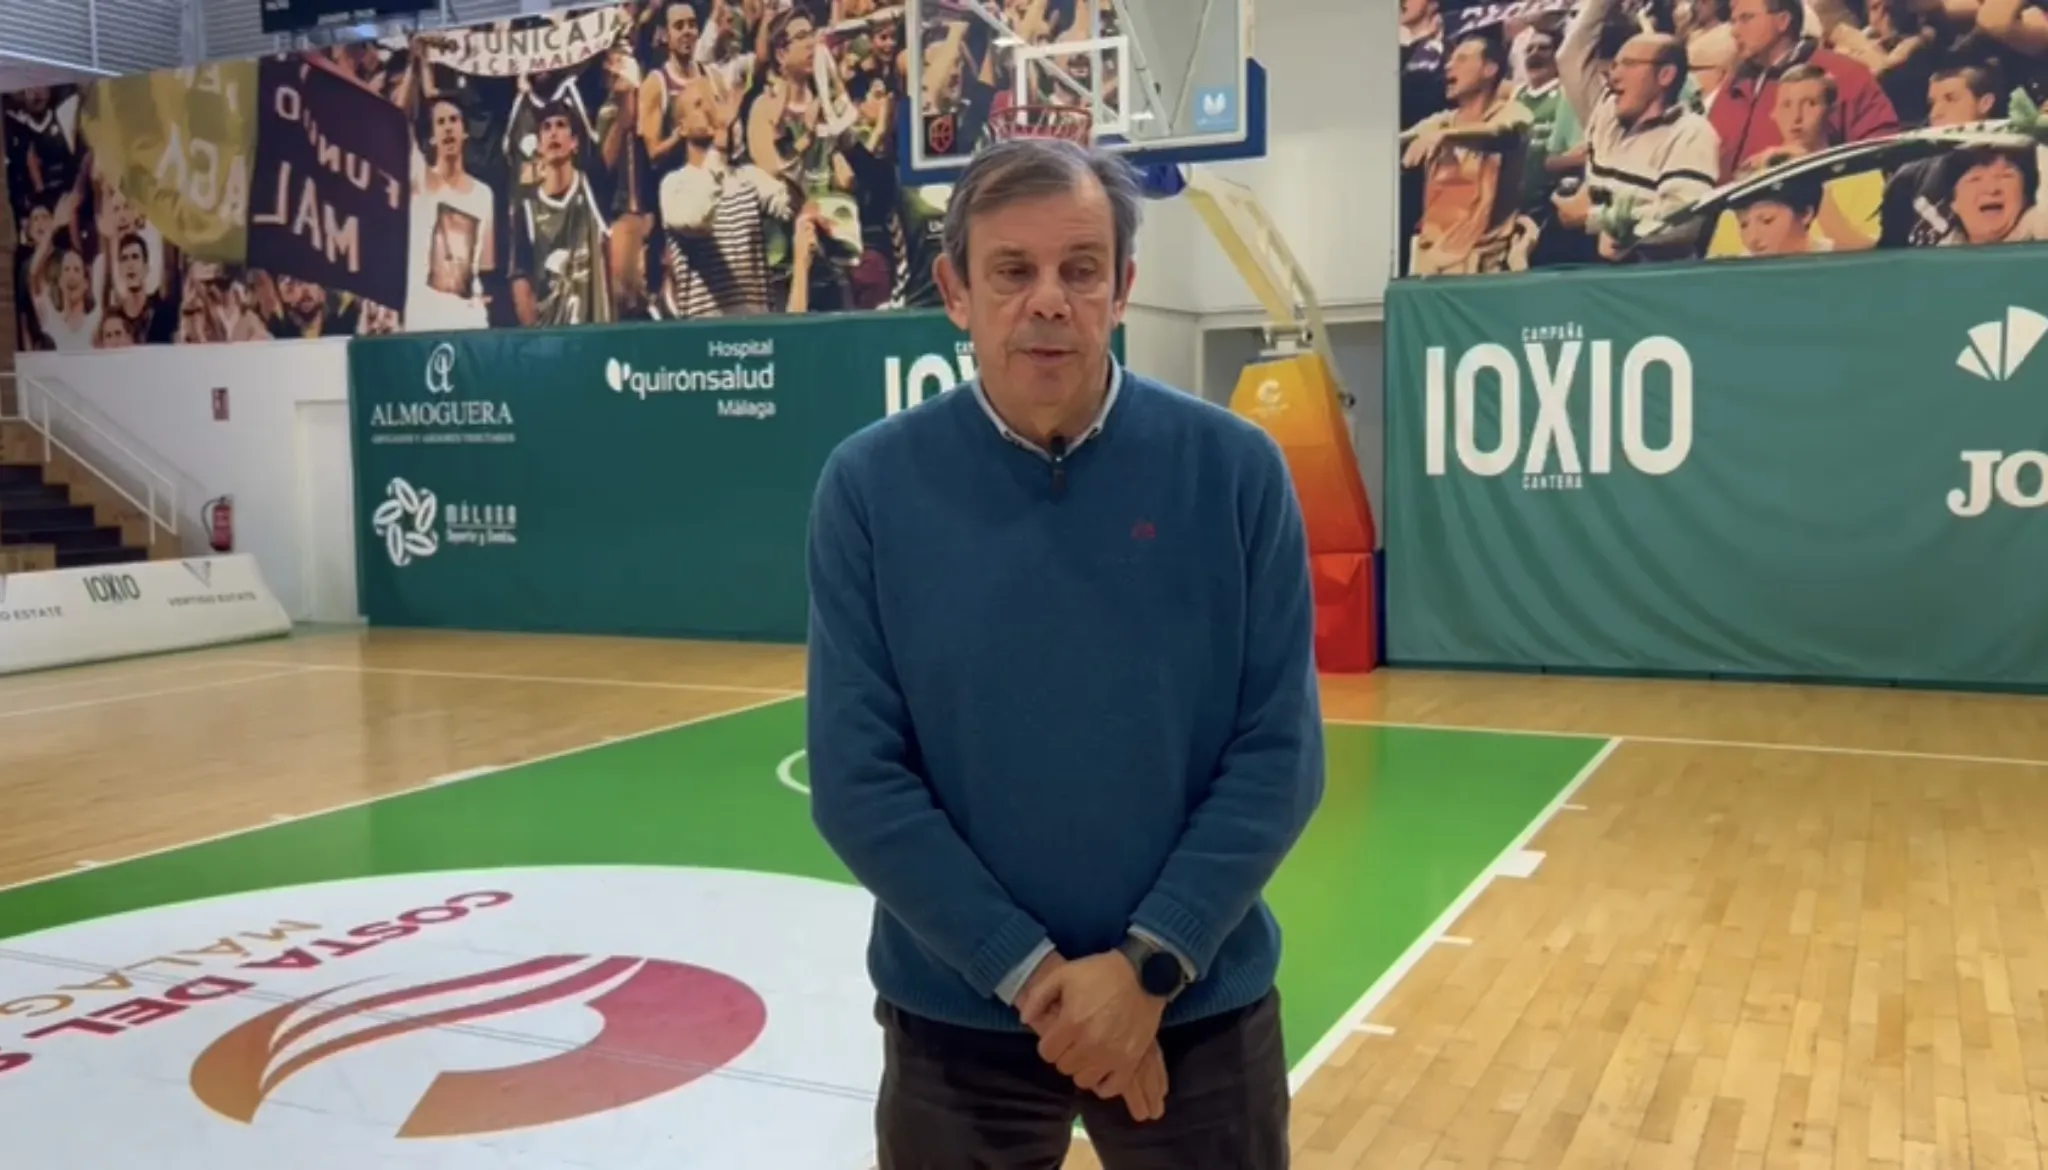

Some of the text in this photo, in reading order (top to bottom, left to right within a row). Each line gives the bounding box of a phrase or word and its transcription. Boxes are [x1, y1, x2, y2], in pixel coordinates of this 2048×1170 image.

[1522, 321, 1583, 341] CAMPAÑA
[708, 338, 774, 359] Hospital
[370, 401, 514, 427] ALMOGUERA
[1523, 475, 1583, 489] CANTERA
[14, 605, 64, 620] ESTATE
[21, 889, 514, 1040] COSTA DEL
